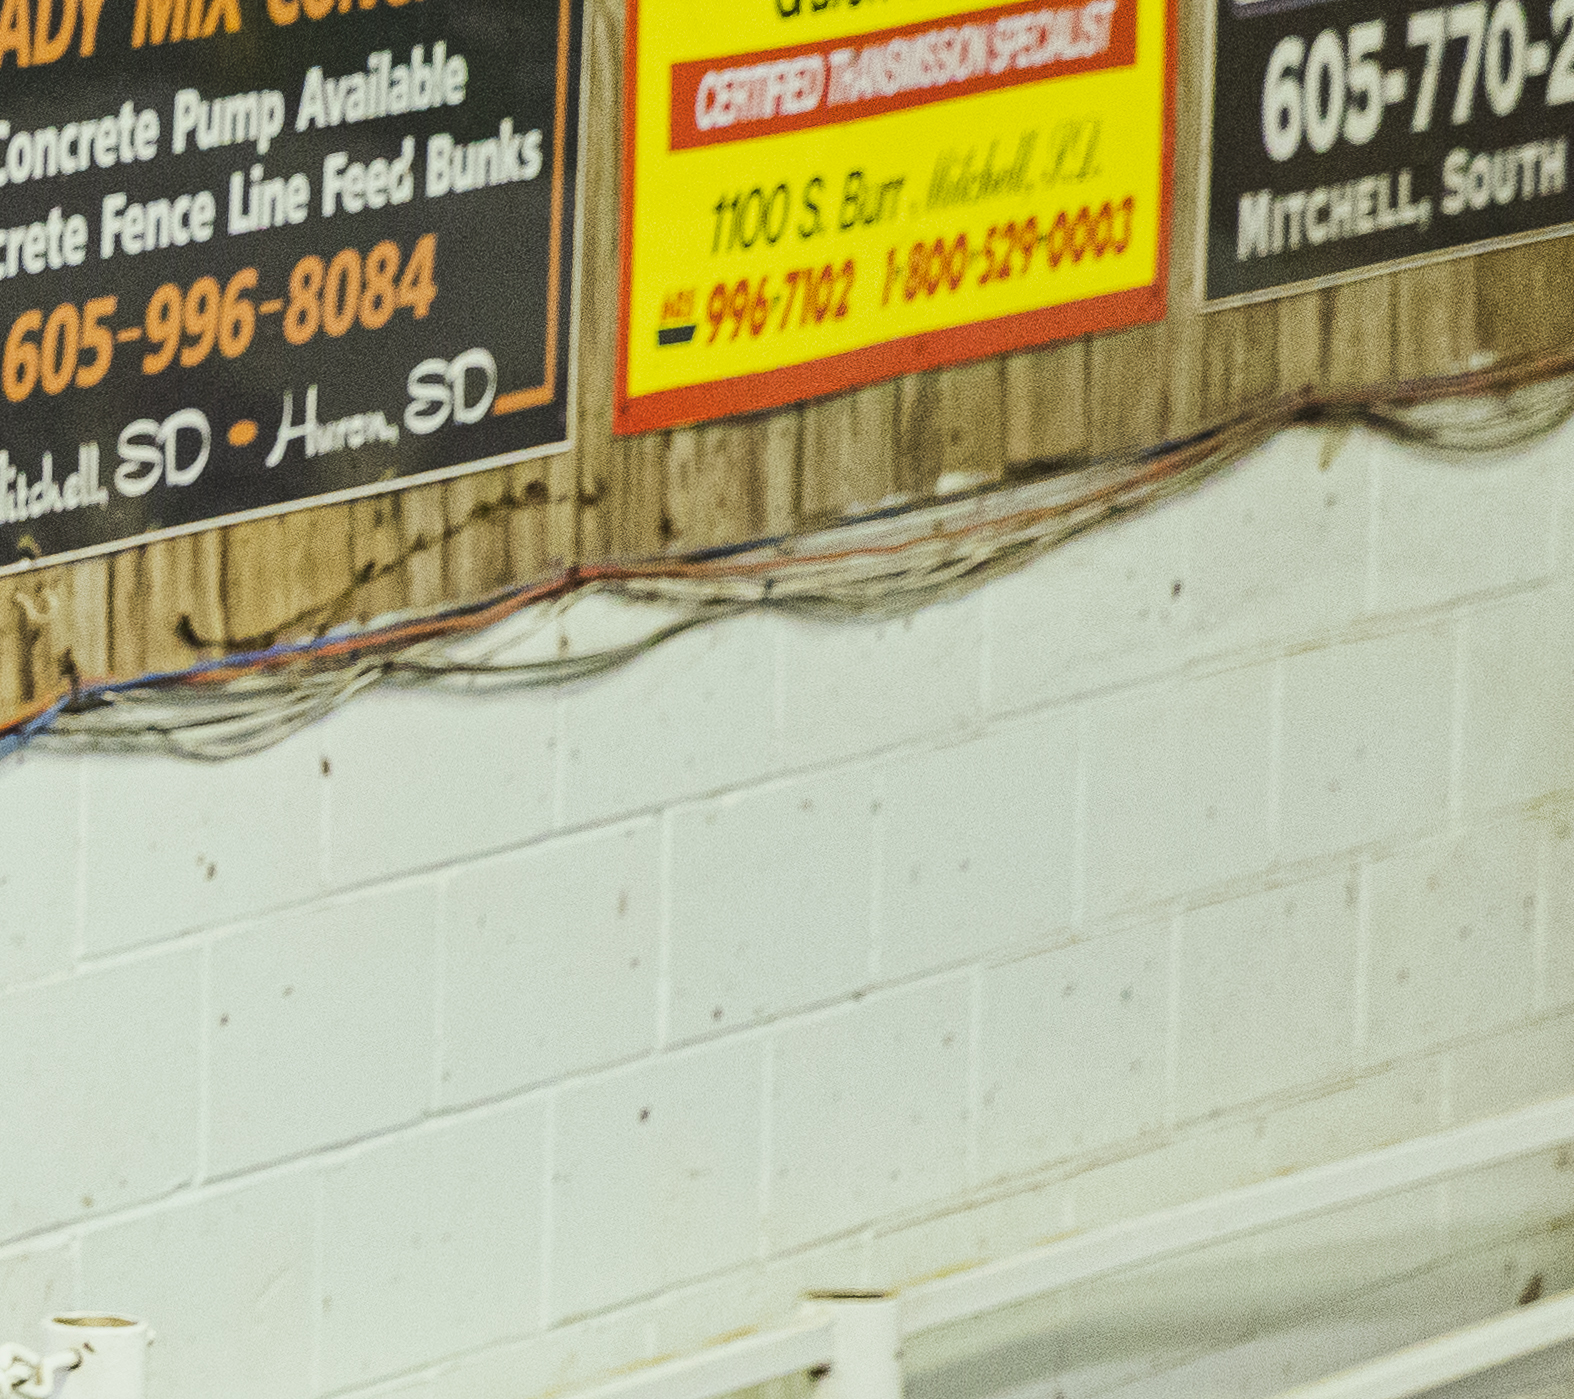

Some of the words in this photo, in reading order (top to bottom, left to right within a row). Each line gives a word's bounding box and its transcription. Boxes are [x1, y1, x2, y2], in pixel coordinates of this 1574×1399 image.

[171, 90, 284, 155] Pump
[297, 40, 468, 132] Available
[1261, 0, 1574, 162] 605-770-2
[100, 184, 214, 259] Fence
[227, 163, 309, 236] Line
[320, 136, 414, 215] Feed
[425, 116, 544, 199] Bunks
[710, 182, 791, 255] 1100
[1, 232, 440, 403] 605-996-8084
[705, 258, 856, 346] 996-7102
[880, 195, 1136, 308] 1-800-529-0003
[113, 407, 211, 498] SD
[404, 346, 498, 435] SD
